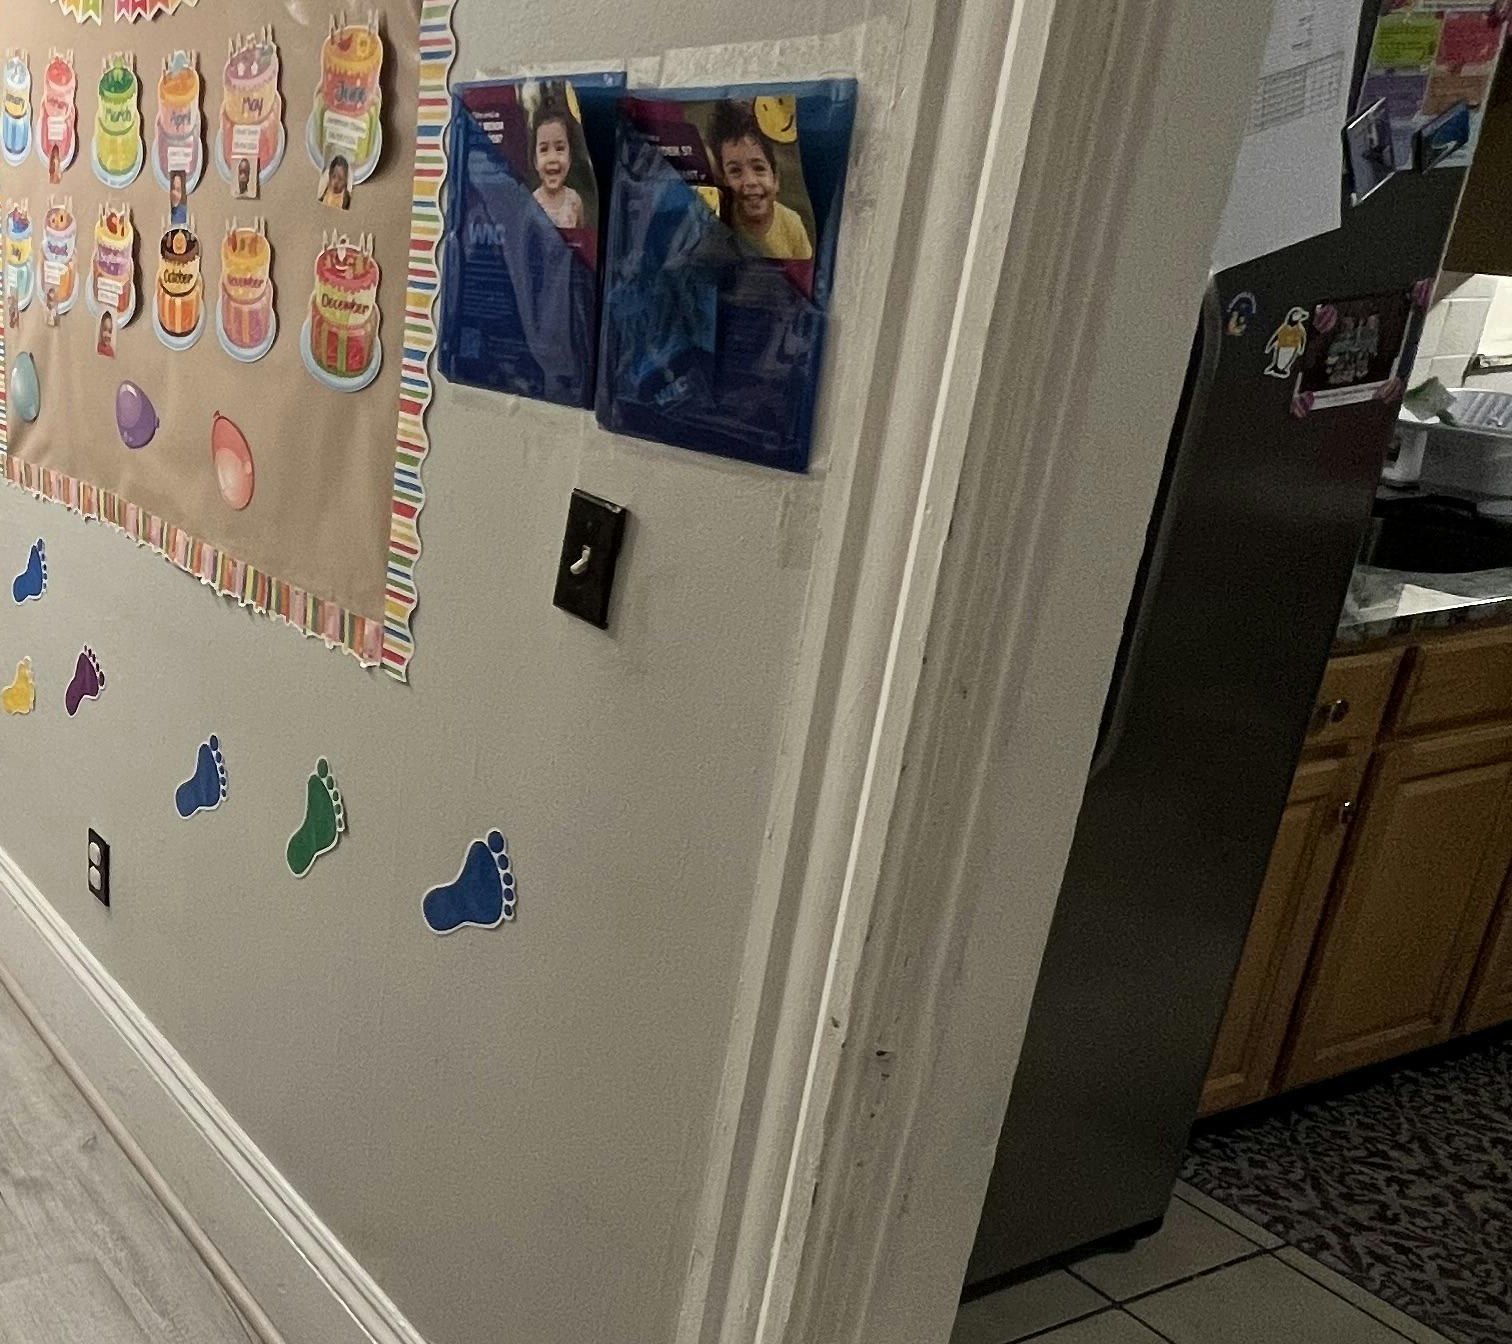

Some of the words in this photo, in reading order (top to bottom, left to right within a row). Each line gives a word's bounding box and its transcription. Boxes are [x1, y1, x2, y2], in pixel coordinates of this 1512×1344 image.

[335, 80, 367, 103] June
[105, 106, 132, 124] March
[242, 96, 263, 116] May
[163, 268, 194, 285] October
[320, 293, 370, 316] December
